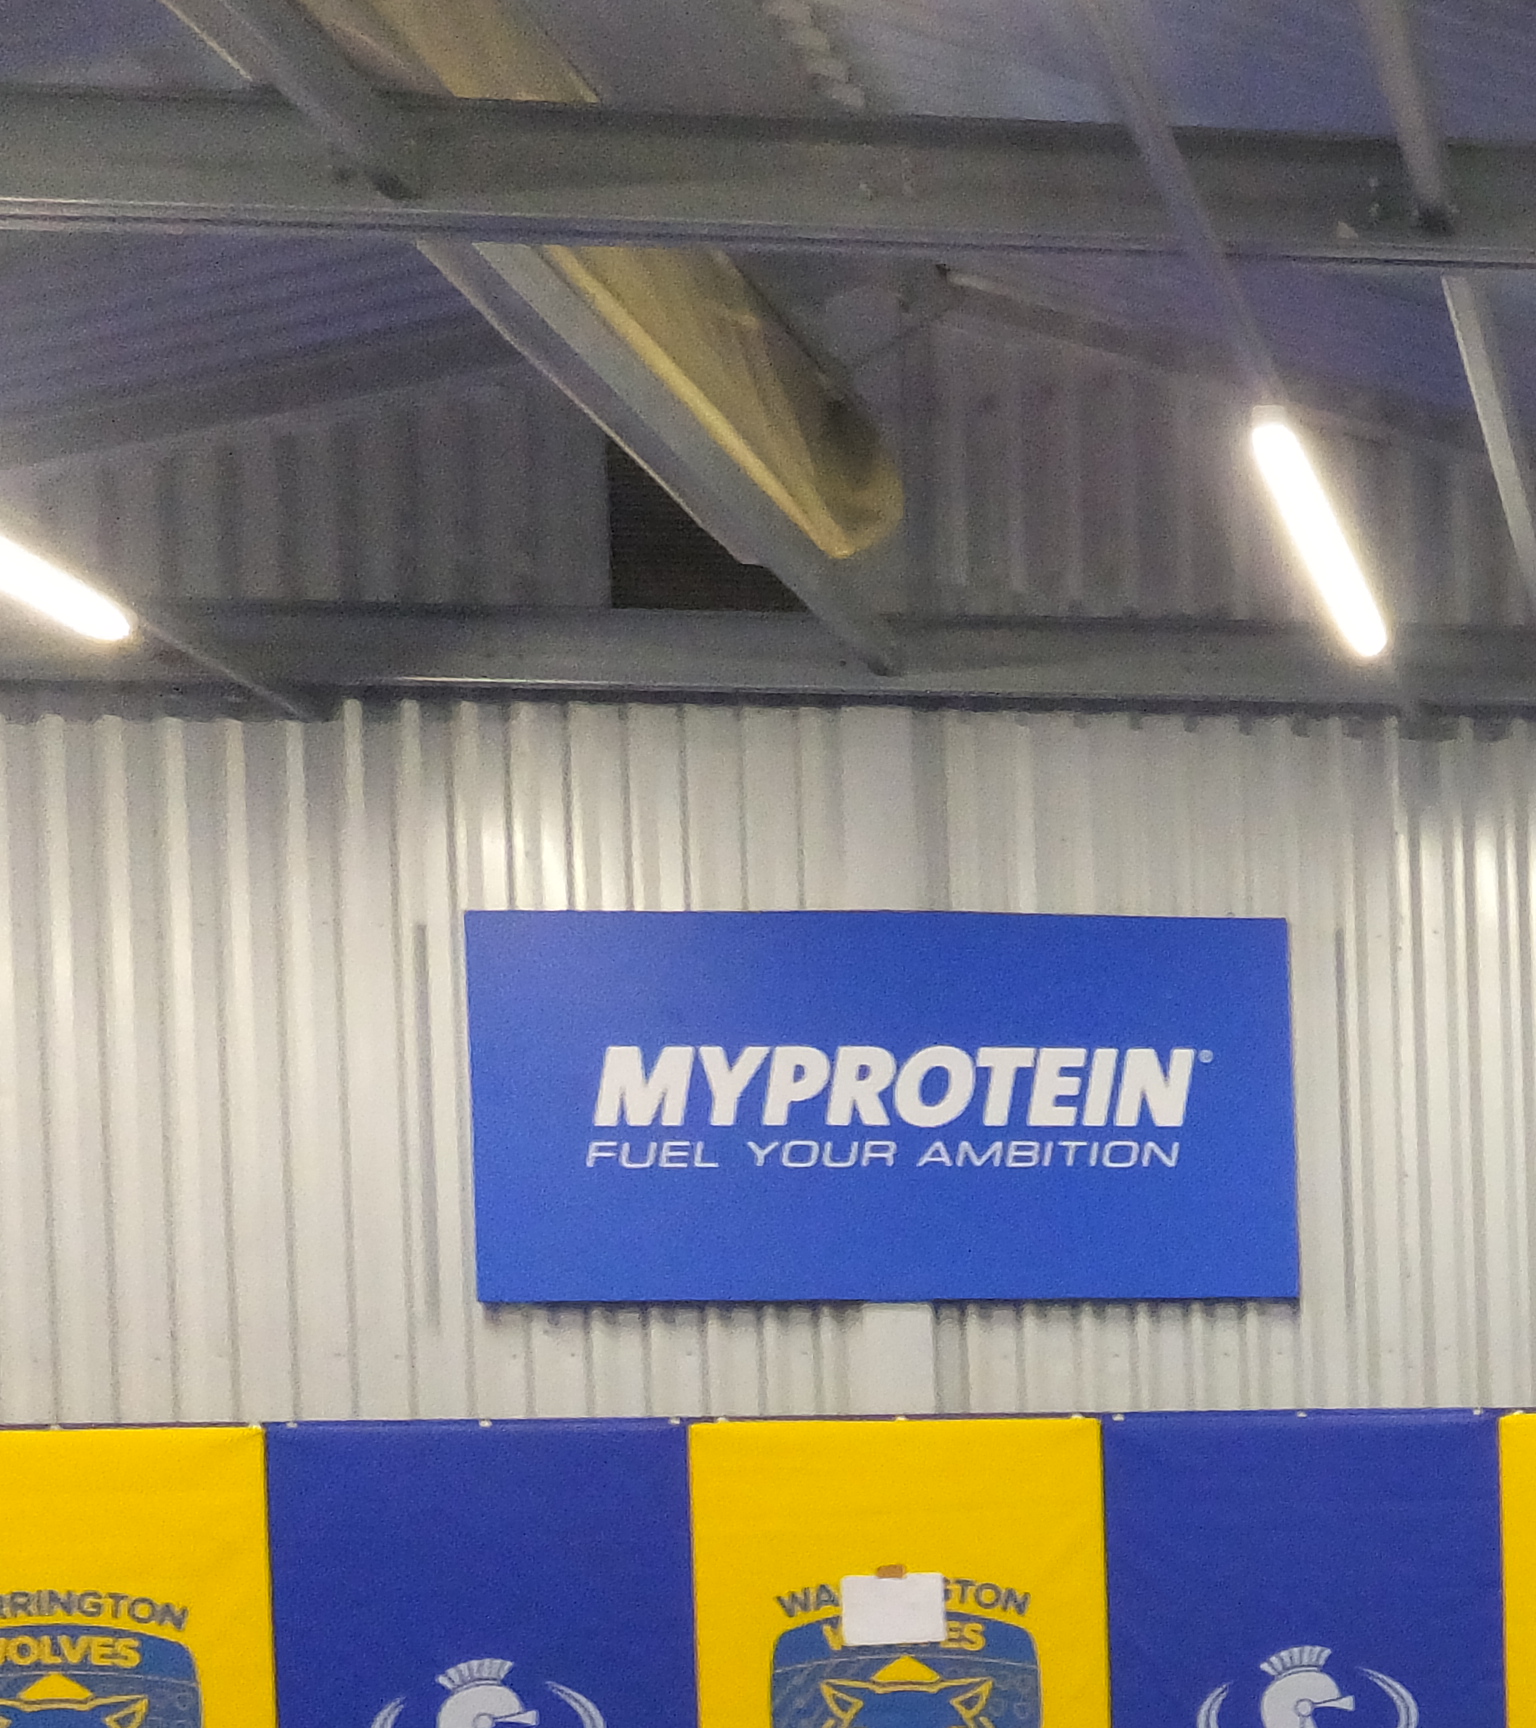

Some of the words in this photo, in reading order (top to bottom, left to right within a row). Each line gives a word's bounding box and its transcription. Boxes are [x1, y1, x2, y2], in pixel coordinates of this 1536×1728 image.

[592, 1044, 1196, 1127] MYPROTEIN
[586, 1140, 719, 1168] FUEL
[747, 1140, 898, 1168] YOUR
[916, 1140, 1181, 1168] AMBITION
[0, 1589, 189, 1632] RINGTON
[776, 1576, 1031, 1617] WATON
[0, 1634, 142, 1669] OLVES
